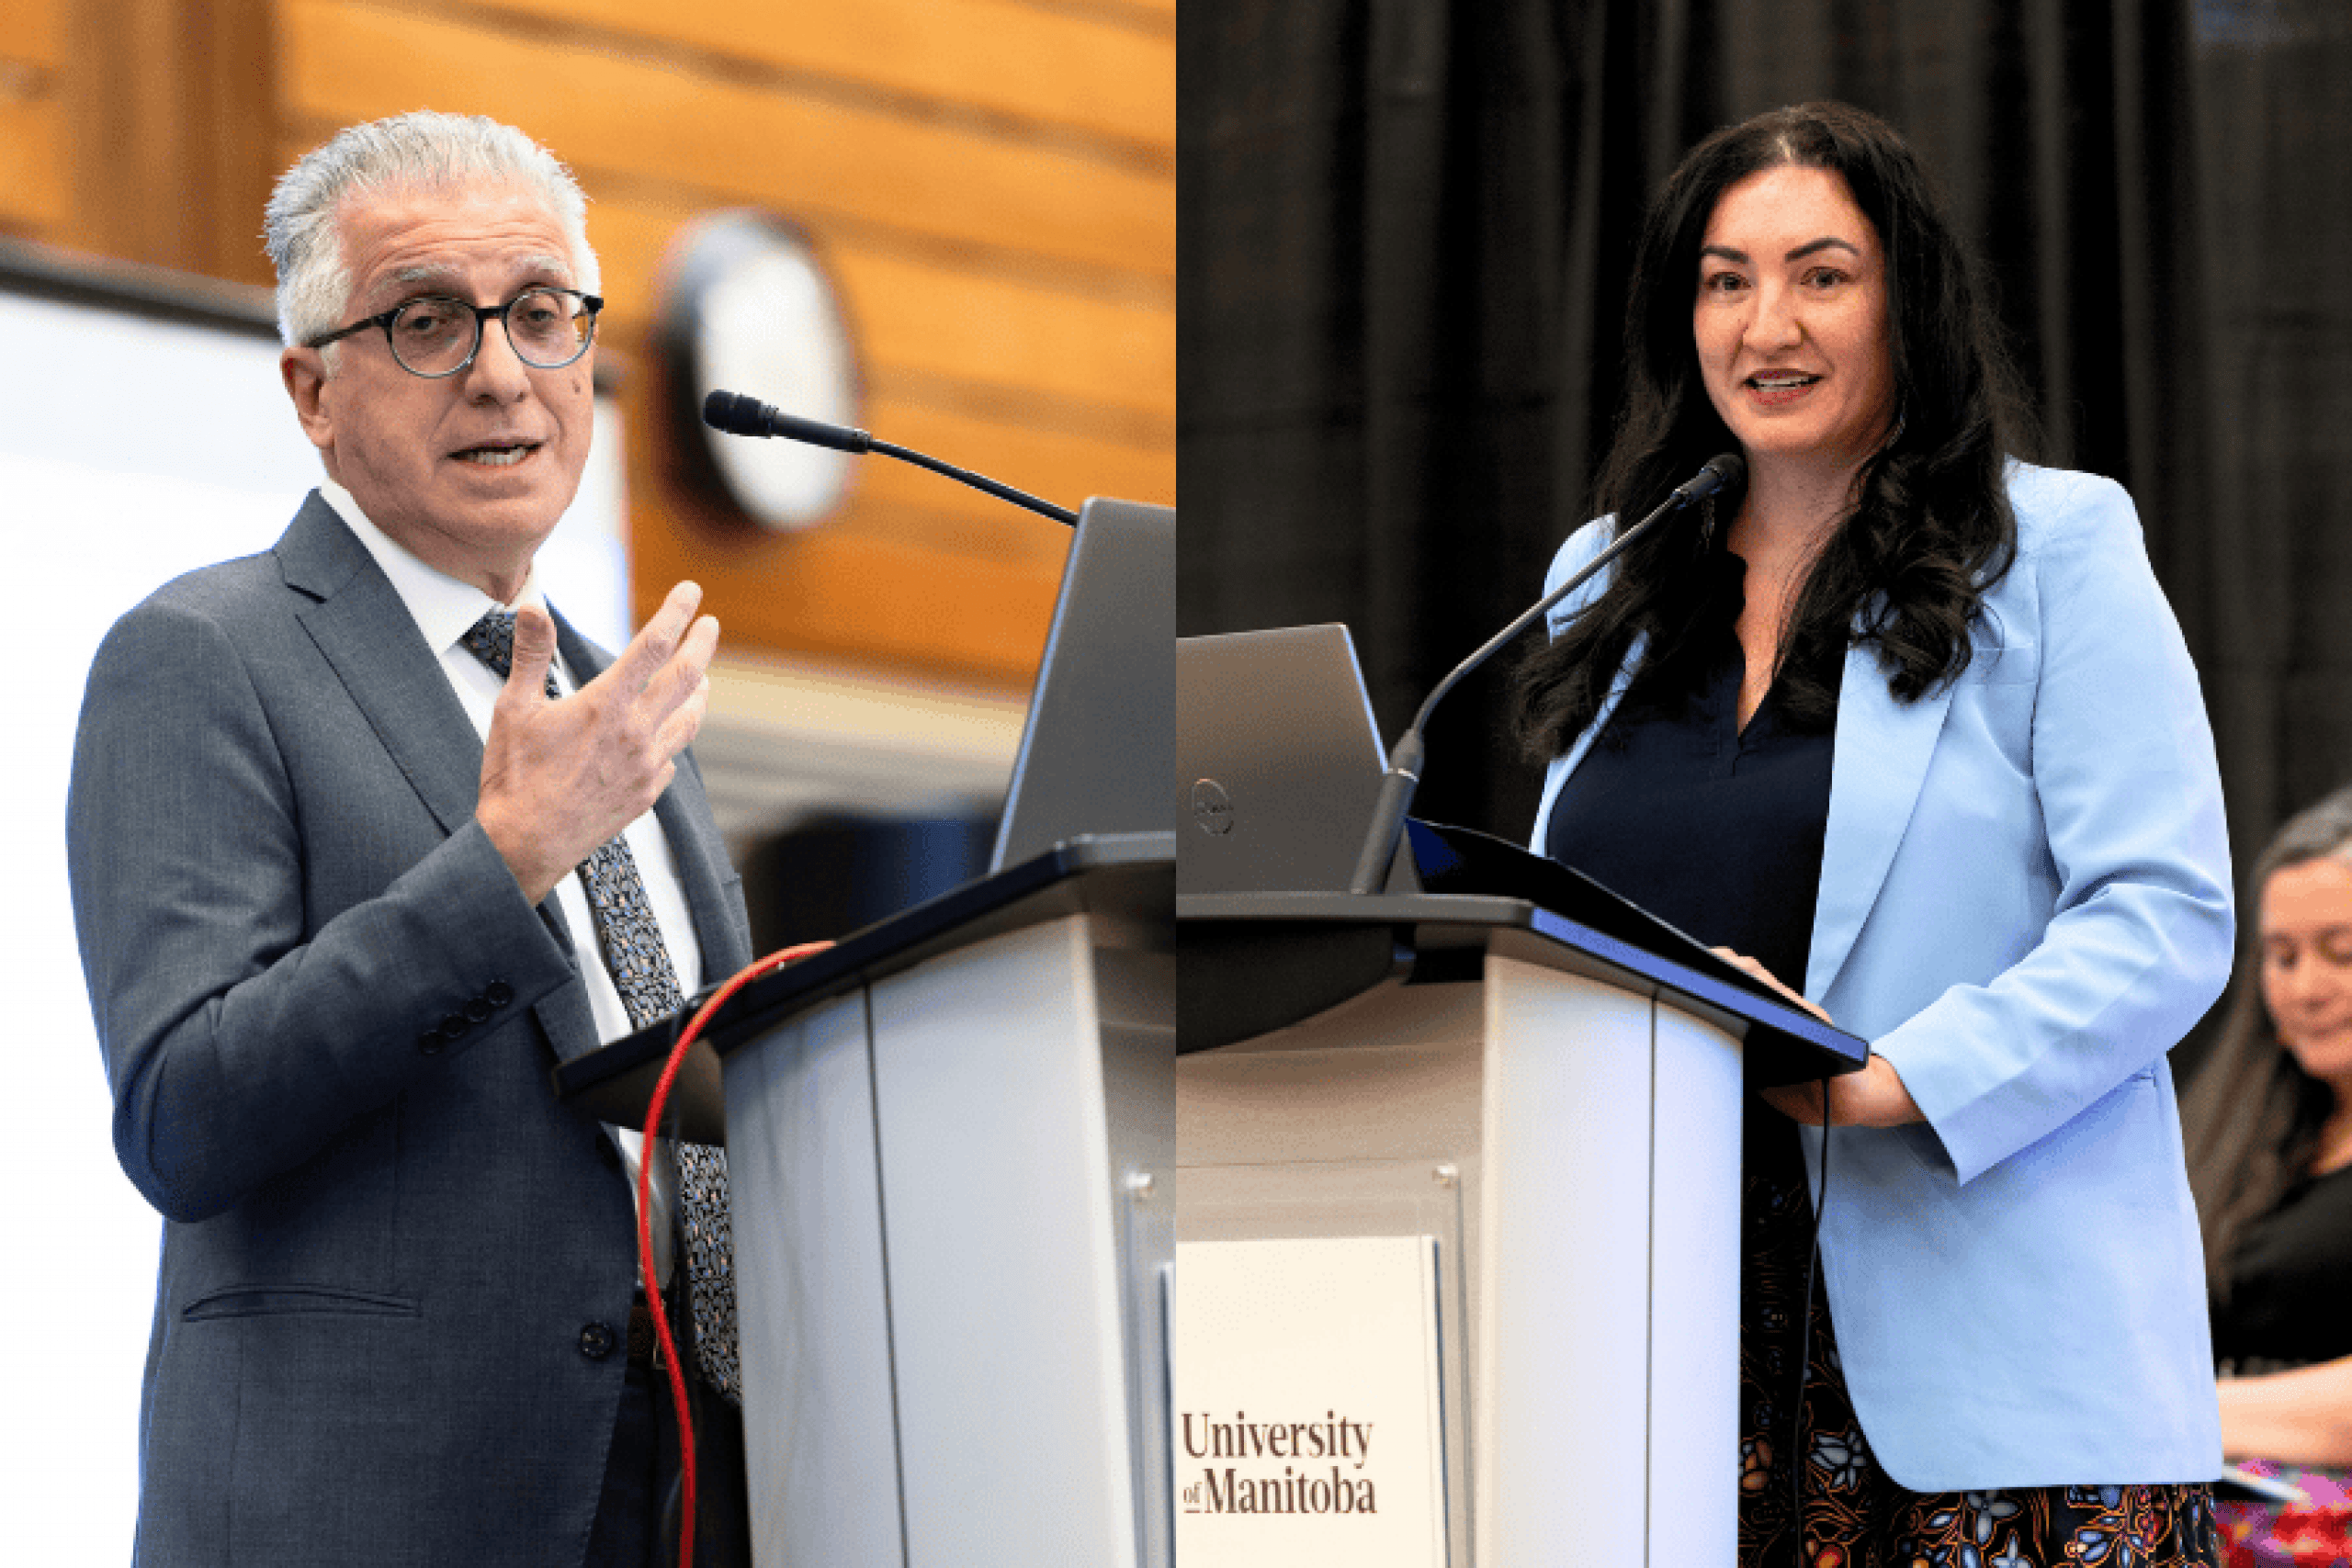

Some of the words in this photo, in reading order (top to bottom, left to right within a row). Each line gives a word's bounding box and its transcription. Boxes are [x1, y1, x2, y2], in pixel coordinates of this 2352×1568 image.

[1182, 1410, 1374, 1470] University
[1182, 1481, 1202, 1507] of
[1204, 1465, 1378, 1514] Manitoba
